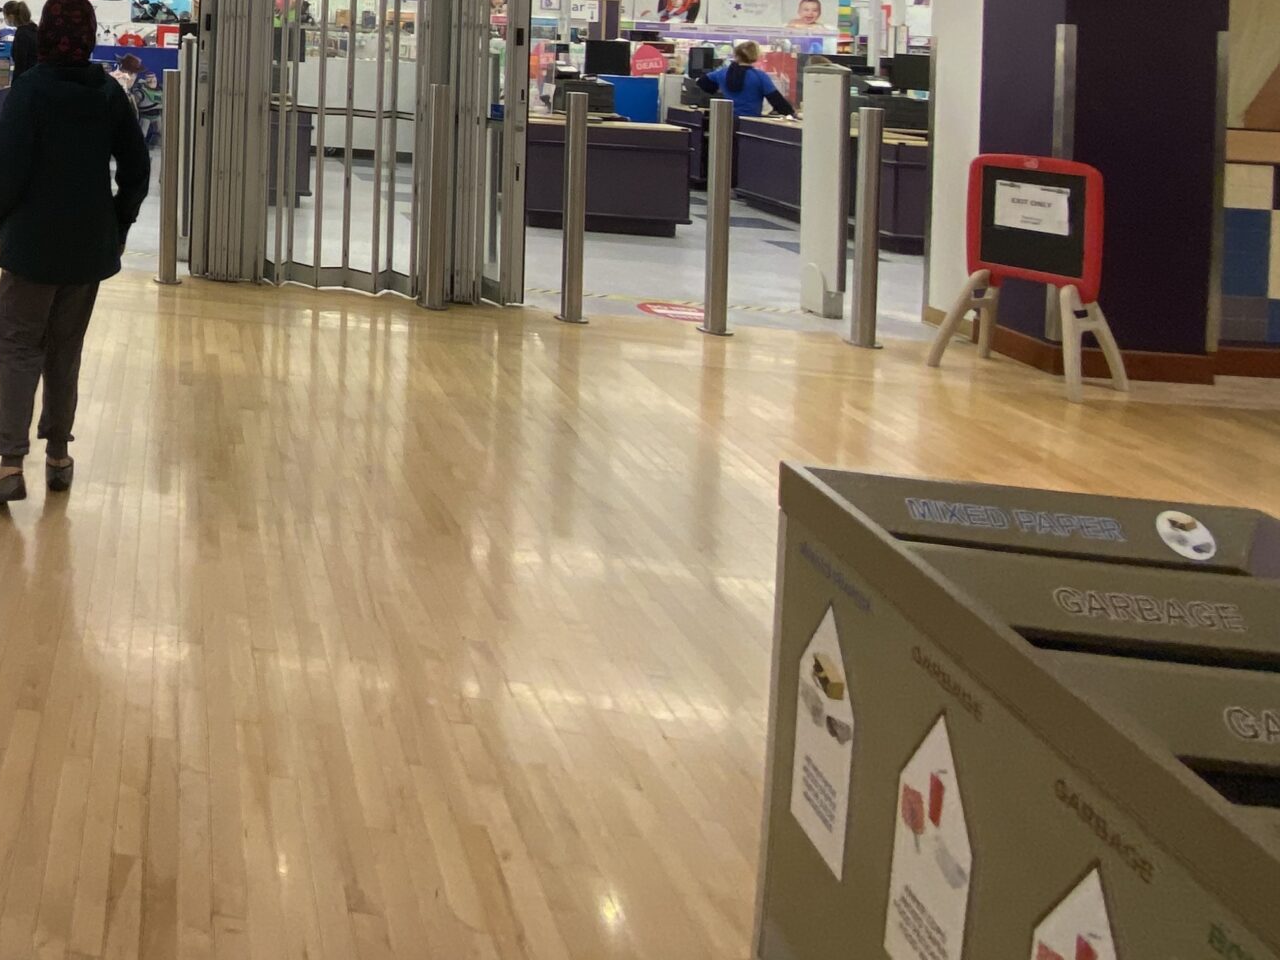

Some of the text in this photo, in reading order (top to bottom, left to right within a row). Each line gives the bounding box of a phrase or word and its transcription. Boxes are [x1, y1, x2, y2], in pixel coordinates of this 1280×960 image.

[1011, 197, 1053, 209] EXIT ONLY
[905, 498, 1126, 542] MIXED PAPER
[1053, 586, 1248, 633] GARBAGE
